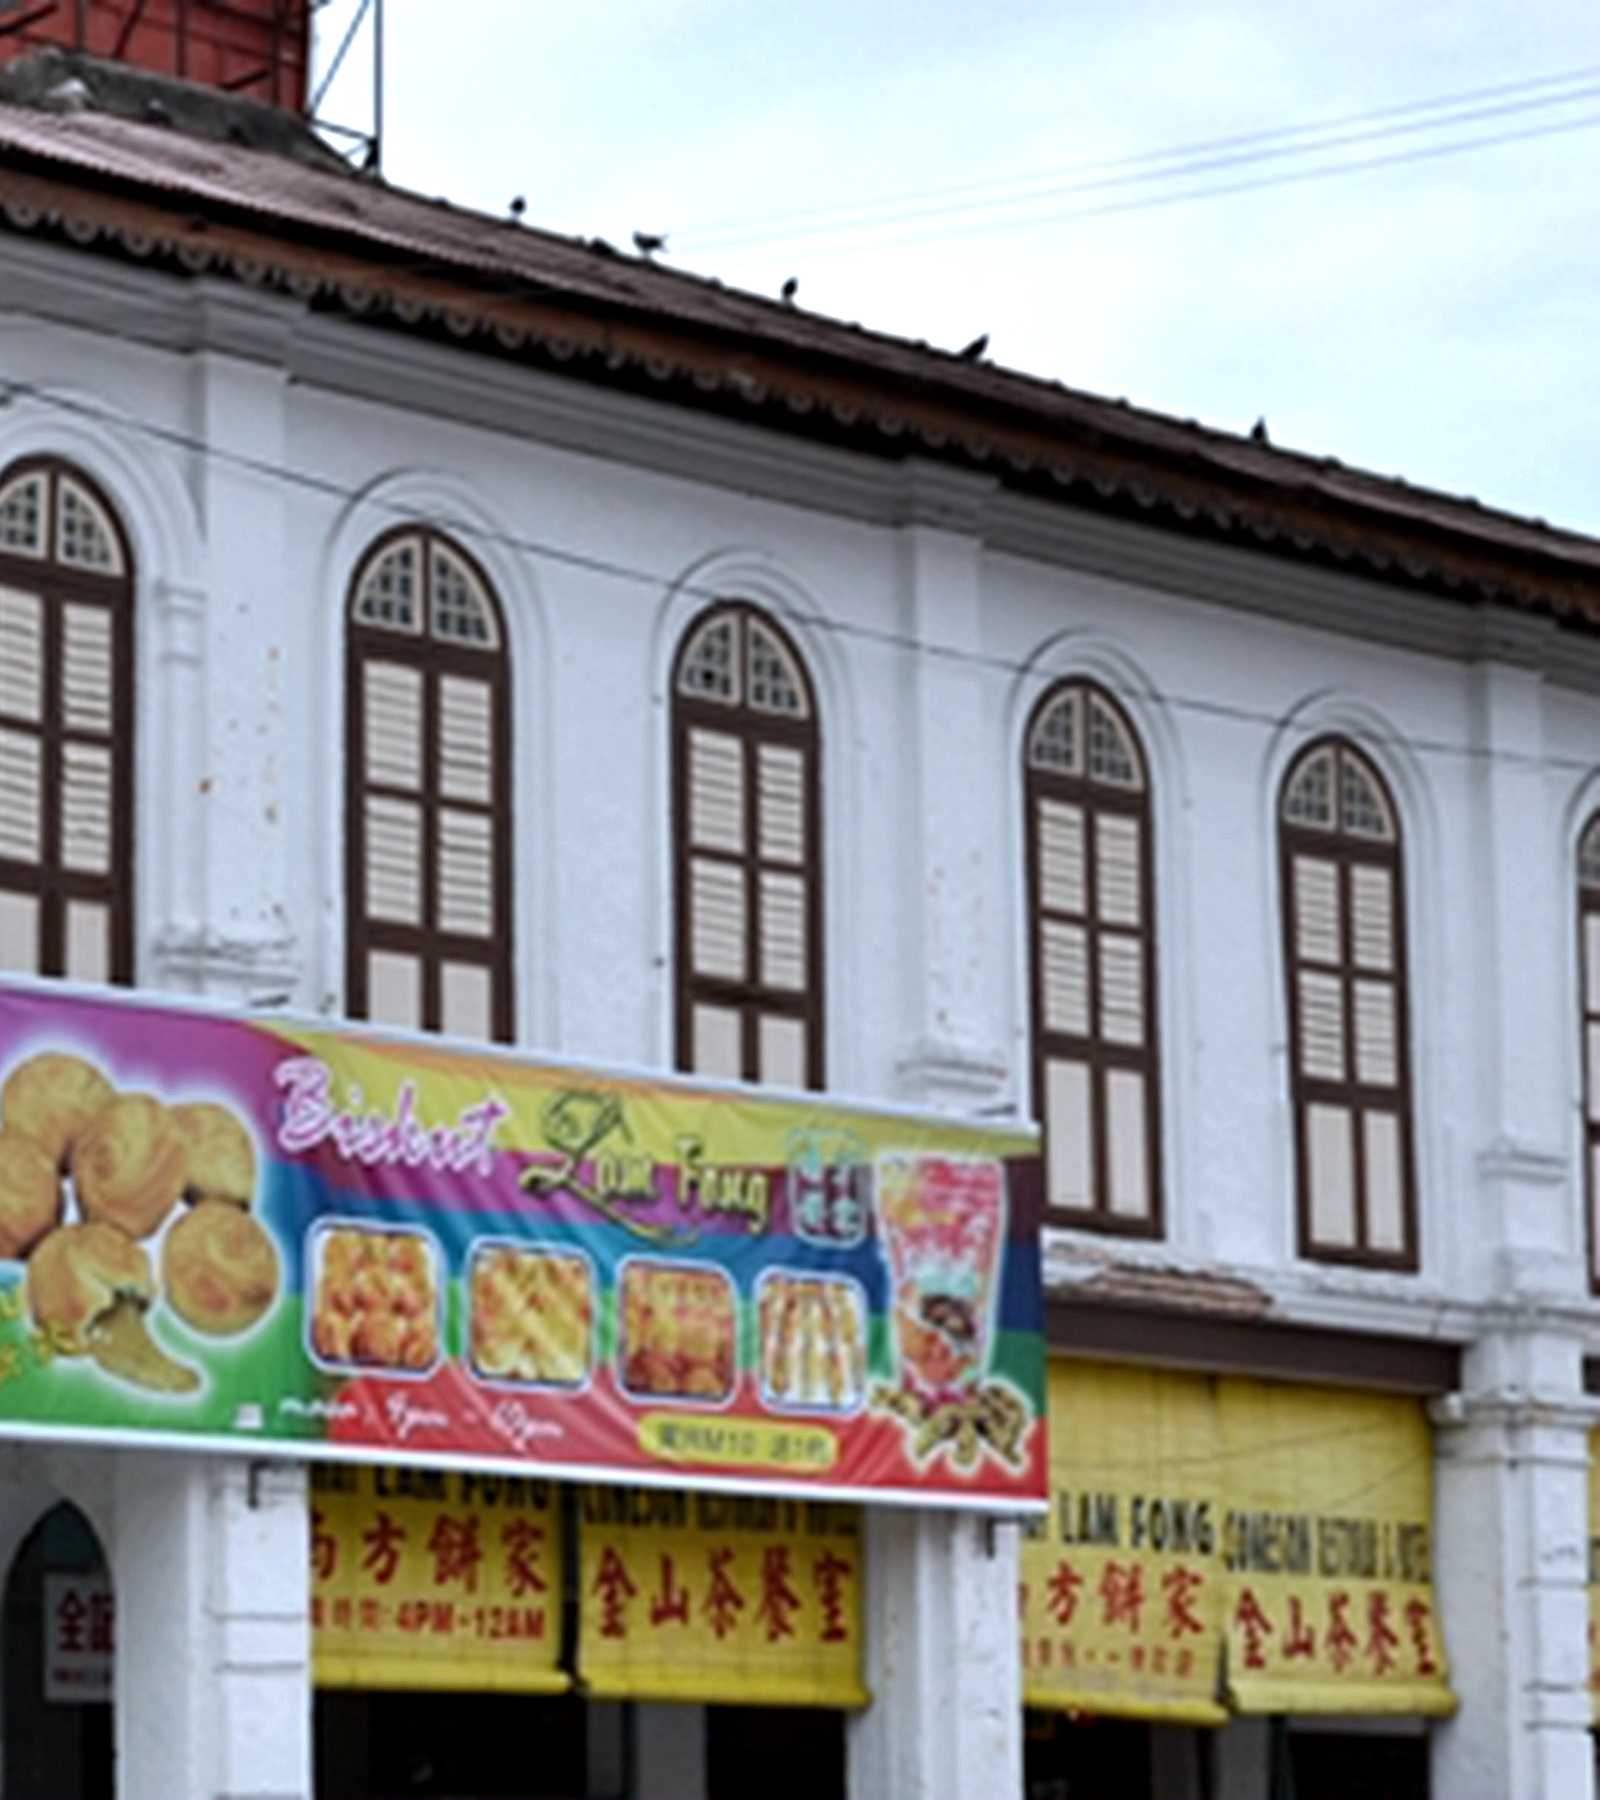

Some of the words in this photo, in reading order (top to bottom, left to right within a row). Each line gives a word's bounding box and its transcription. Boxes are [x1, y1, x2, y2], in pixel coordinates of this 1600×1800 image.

[674, 1137, 770, 1232] Fong
[1058, 1492, 1120, 1546] LAM
[1130, 1498, 1216, 1556] FONG
